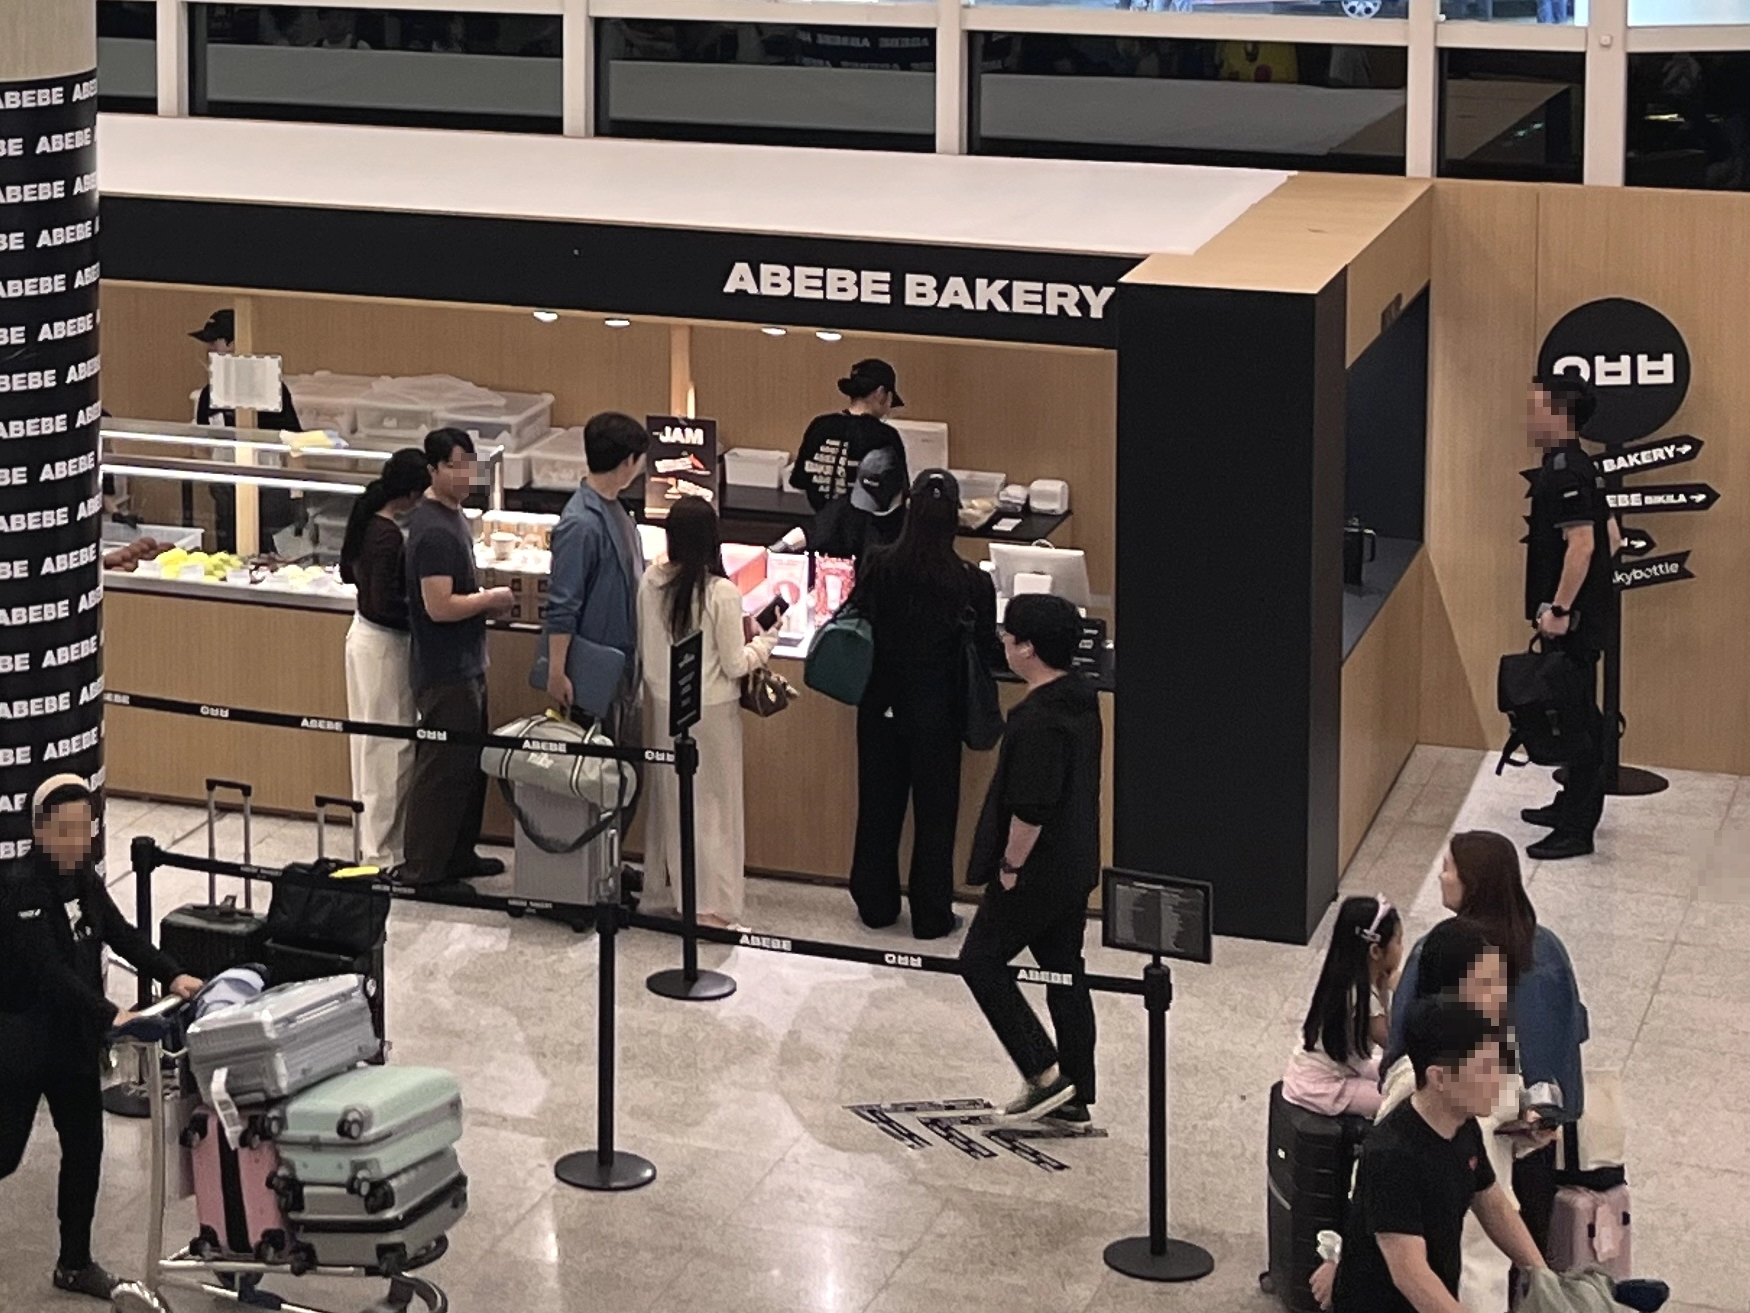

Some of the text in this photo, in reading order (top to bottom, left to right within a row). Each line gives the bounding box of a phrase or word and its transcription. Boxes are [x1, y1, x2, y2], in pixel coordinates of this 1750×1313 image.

[36, 128, 91, 154] ABEBE
[36, 222, 92, 248] ABEBE
[723, 263, 1115, 318] ABEBE BAKERY
[38, 313, 93, 342] ABEBE
[659, 426, 704, 445] JAM
[39, 451, 95, 482] ABEBE
[1602, 444, 1676, 473] BAKERY
[1605, 492, 1642, 508] EBE
[41, 543, 97, 576] ABEBE
[42, 635, 97, 669] ABEBE
[105, 693, 130, 705] EBE
[301, 717, 344, 732] ABEBE
[522, 739, 567, 753] ABEBE
[43, 726, 99, 761] ABEBE
[739, 934, 792, 951] ABEBE
[1017, 968, 1074, 986] ABEBE
